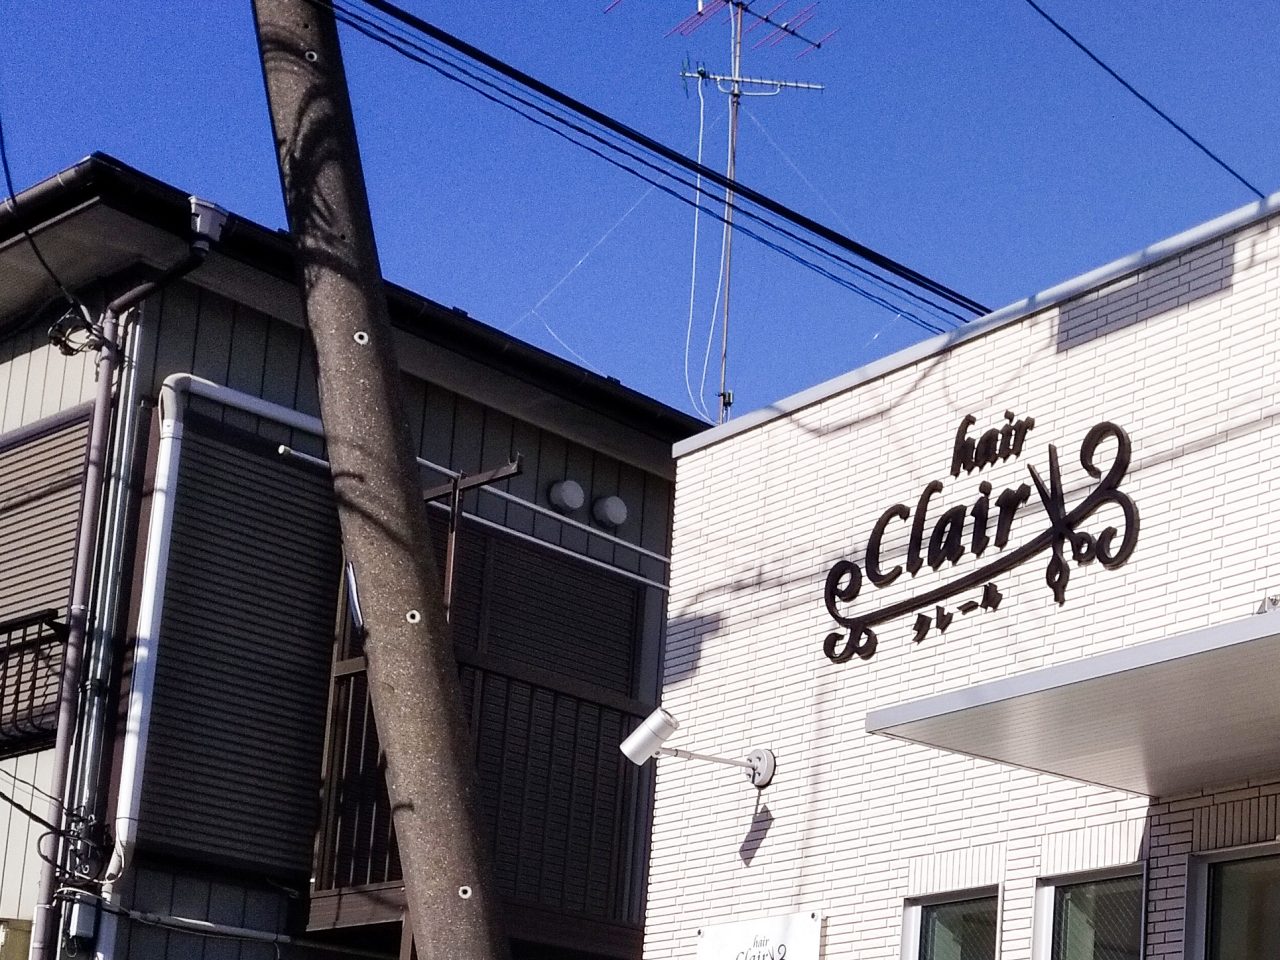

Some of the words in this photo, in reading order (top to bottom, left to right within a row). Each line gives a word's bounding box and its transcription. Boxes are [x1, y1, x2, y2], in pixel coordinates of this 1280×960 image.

[950, 409, 1035, 479] hair
[865, 479, 1032, 588] Clair
[912, 581, 1003, 645] クレール
[753, 934, 770, 948] hair
